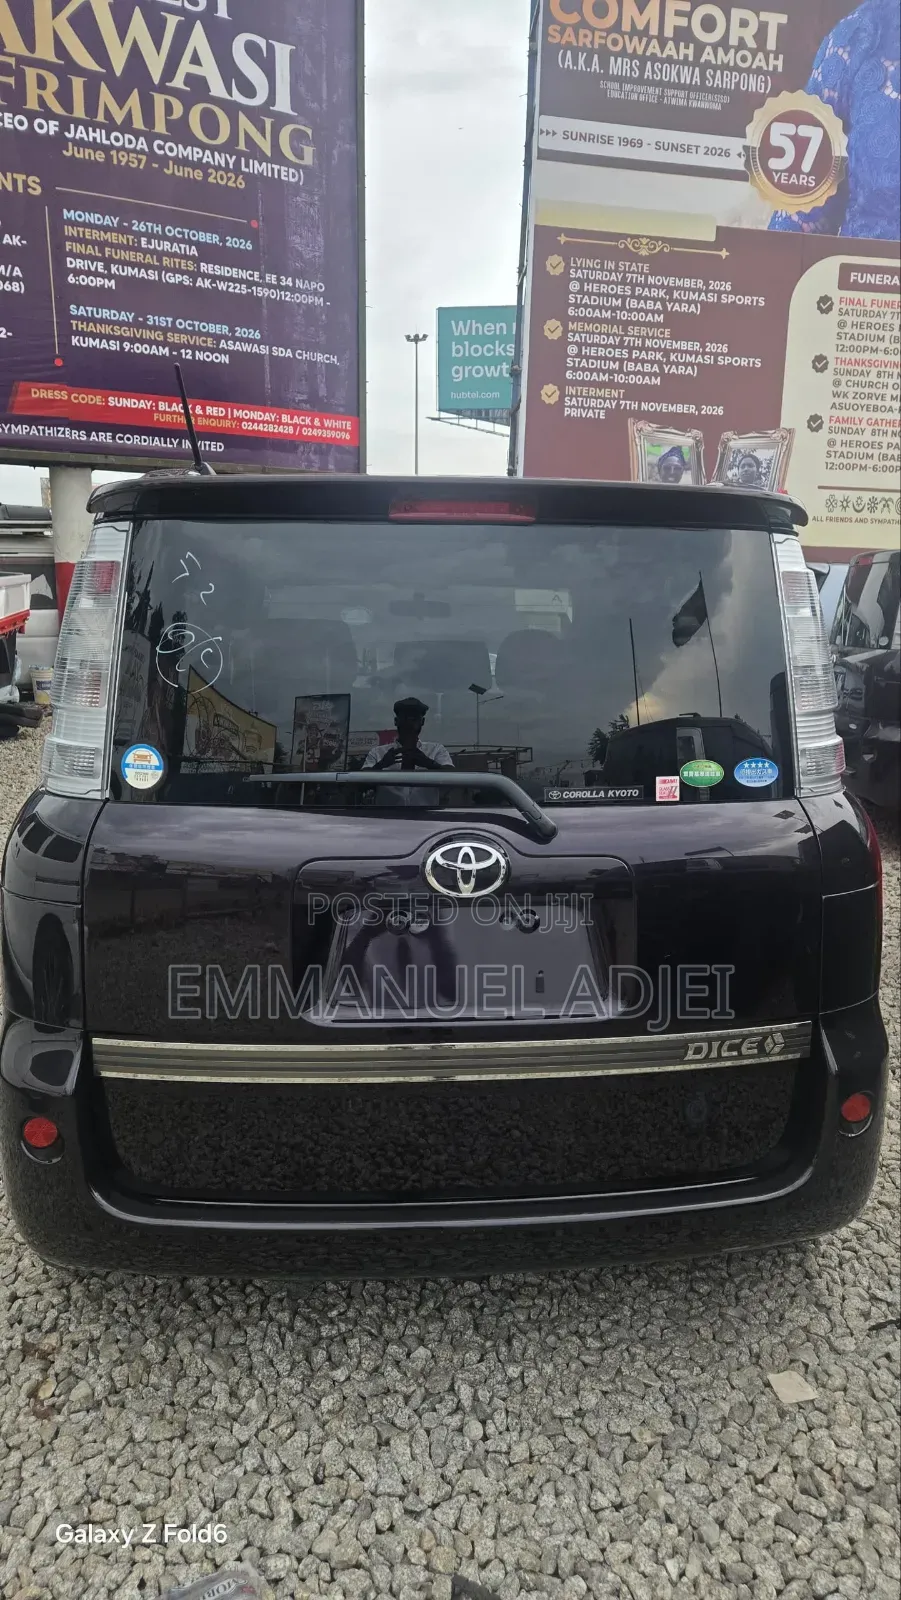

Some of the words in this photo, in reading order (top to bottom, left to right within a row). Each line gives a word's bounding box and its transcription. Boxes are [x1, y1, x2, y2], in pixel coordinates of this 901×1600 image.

[550, 0, 788, 51] COMFORT
[548, 24, 694, 61] SARFOWAAH
[700, 45, 784, 72] AMOAH
[558, 49, 604, 74] (A.K.A.
[609, 56, 640, 78] MRS
[644, 61, 701, 86] ASOKWA
[706, 68, 772, 94] SARPONG)
[600, 80, 620, 90] SCHOOL
[622, 83, 662, 96] IMPROVEMENT
[664, 88, 688, 100] SUPPORT
[607, 89, 638, 101] EDUCATION
[639, 93, 658, 104] OFFICE
[33, 118, 59, 135] OF
[64, 123, 149, 152] JAHLODA
[153, 140, 236, 169] COMPANY
[241, 157, 304, 186] LIMITED)
[562, 130, 614, 145] SUNRISE
[618, 136, 643, 148] 1969
[654, 140, 701, 155] SUNSET
[703, 146, 731, 158] 2026
[768, 121, 824, 173] 57
[62, 141, 105, 162] June
[110, 149, 147, 169] 1957
[164, 160, 203, 181] June
[207, 168, 246, 189] 2026
[772, 171, 816, 187] YEARS
[63, 208, 119, 228] MONDAY
[132, 220, 162, 235] 26TH
[165, 225, 222, 246] OCTOBER,
[225, 236, 252, 251] 2026
[64, 225, 138, 246] INTERMENT:
[141, 237, 198, 257] EJURATIA
[65, 241, 102, 257] FINAL
[104, 247, 160, 266] FUNERAL
[162, 256, 197, 272] RITES:
[200, 262, 262, 283] RESIDENCE,
[266, 273, 278, 285] EE
[280, 276, 292, 287] 34
[296, 278, 325, 293] NAPO
[66, 257, 108, 274] DRIVE,
[110, 264, 158, 281] KUMASI
[161, 270, 193, 287] (GPS:
[570, 256, 601, 269] LYING
[604, 260, 615, 271] IN
[618, 261, 650, 273] STATE
[67, 273, 116, 290] 6:00PM
[569, 268, 624, 282] SATURDAY
[626, 273, 645, 284] 7TH
[648, 274, 706, 290] NOVEMBER,
[708, 280, 732, 292] 2026
[568, 280, 580, 292] @
[584, 282, 632, 296] HEROES
[635, 286, 670, 300] PARK,
[672, 289, 718, 302] KUMASI
[720, 293, 766, 307] SPORTS
[839, 296, 868, 308] FINAL
[568, 294, 622, 307] STADIUM
[626, 297, 663, 311] (BABA
[666, 302, 701, 315] YARA)
[838, 307, 888, 319] SATURDAY
[69, 304, 135, 323] SATURDAY
[146, 315, 173, 328] 31ST
[176, 318, 232, 336] OCTOBER,
[234, 326, 261, 340] 2026
[567, 306, 664, 324] 6:00AM-10:00AM
[451, 320, 507, 336] When
[568, 321, 625, 335] MEMORIAL
[627, 325, 671, 338] SERVICE
[851, 320, 895, 332] HEROES
[70, 320, 164, 342] THANKSGIVING
[166, 332, 216, 348] SERVICE:
[219, 339, 269, 355] ASAWASI
[272, 346, 293, 359] SDA
[296, 350, 340, 366] CHURCH,
[567, 332, 621, 346] SATURDAY
[623, 336, 642, 347] 7TH
[645, 338, 702, 353] NOVEMBER,
[705, 342, 729, 354] 2026
[836, 331, 886, 343] STADIUM
[71, 335, 120, 352] KUMASI
[122, 341, 170, 357] 9:00AM
[180, 348, 192, 360] 12
[196, 350, 230, 365] NOON
[451, 340, 515, 358] blocks
[566, 344, 578, 356] @
[582, 345, 629, 358] HEROES
[632, 350, 666, 362] PARK,
[670, 352, 714, 365] KUMASI
[717, 355, 762, 368] SPORTS
[566, 357, 620, 371] STADIUM
[623, 360, 660, 374] (BABA
[663, 364, 698, 377] YARA)
[833, 368, 872, 378] SUNDAY
[876, 370, 894, 380] 8TH
[565, 370, 661, 386] 6:00AM-10:00AM
[846, 379, 889, 390] CHURCH
[450, 390, 500, 400] hubtel.com
[565, 385, 626, 400] INTERMENT
[832, 390, 850, 400] WK
[852, 391, 887, 402] ZORVE
[31, 388, 68, 400] DRESS
[70, 394, 106, 405] CODE:
[108, 396, 156, 410] SUNDAY:
[206, 406, 226, 417] RED
[234, 408, 279, 422] MONDAY:
[282, 414, 312, 426] BLACK
[314, 416, 322, 427] &
[324, 418, 352, 430] WHITE
[564, 396, 618, 410] SATURDAY
[620, 400, 638, 411] 7TH
[641, 401, 698, 416] NOVEMBER,
[700, 404, 724, 416] 2026
[564, 407, 606, 420] PRIVATE
[198, 416, 240, 429] ENQUIRY:
[242, 421, 294, 434] 0244282428
[302, 427, 351, 441] 0249359096
[829, 416, 864, 426] FAMILY
[90, 431, 112, 443] ARE
[116, 433, 180, 448] CORDIALLY
[828, 426, 866, 436] SUNDAY
[870, 428, 888, 438] 8TH
[840, 439, 884, 450] HEROES
[825, 450, 874, 461] STADIUM
[826, 516, 853, 524] FRIENDS
[854, 516, 868, 524] AND
[562, 789, 606, 799] COROLLA
[608, 788, 639, 798] KYOTO
[683, 1036, 763, 1060] DICE
